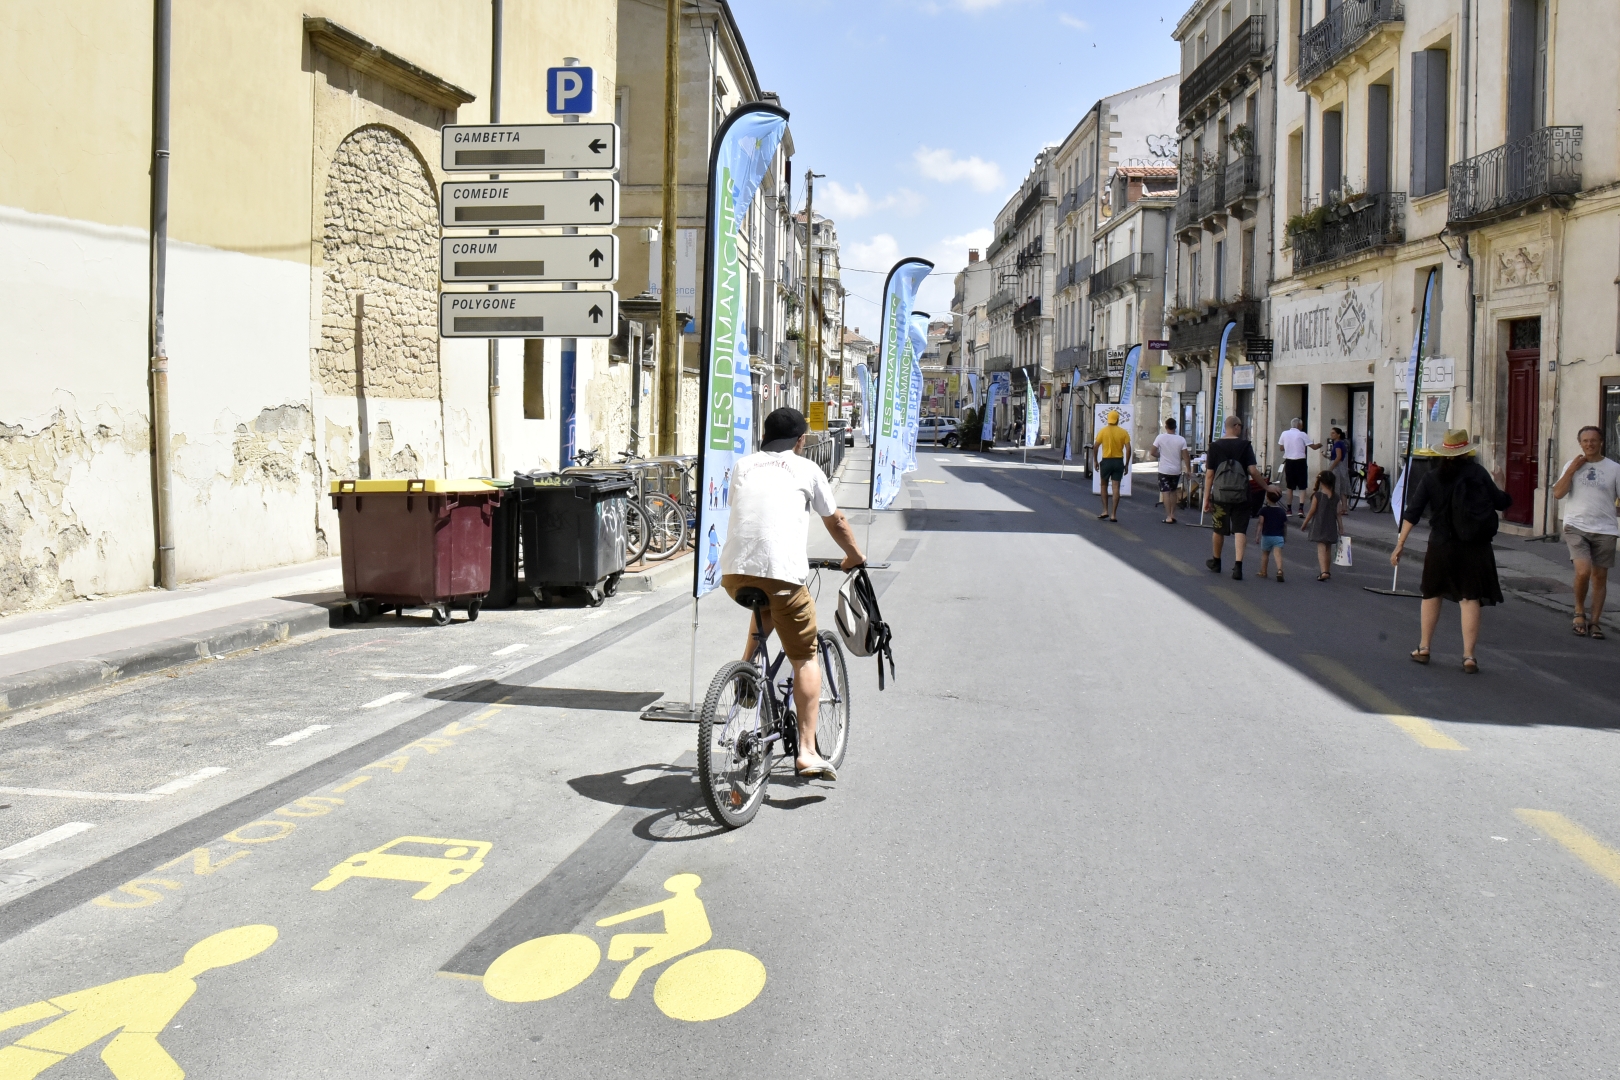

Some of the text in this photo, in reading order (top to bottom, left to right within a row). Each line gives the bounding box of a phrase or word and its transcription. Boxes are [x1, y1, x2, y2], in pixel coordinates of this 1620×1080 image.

[556, 71, 583, 110] P
[454, 131, 521, 144] GAMBETTA
[453, 187, 510, 200] COMEDIE
[452, 243, 498, 255] CORUM
[452, 298, 517, 311] POLYGONE
[1281, 306, 1330, 352] LA CAGETTE
[713, 391, 733, 444] LES
[883, 407, 892, 436] LES
[734, 417, 750, 454] DE
